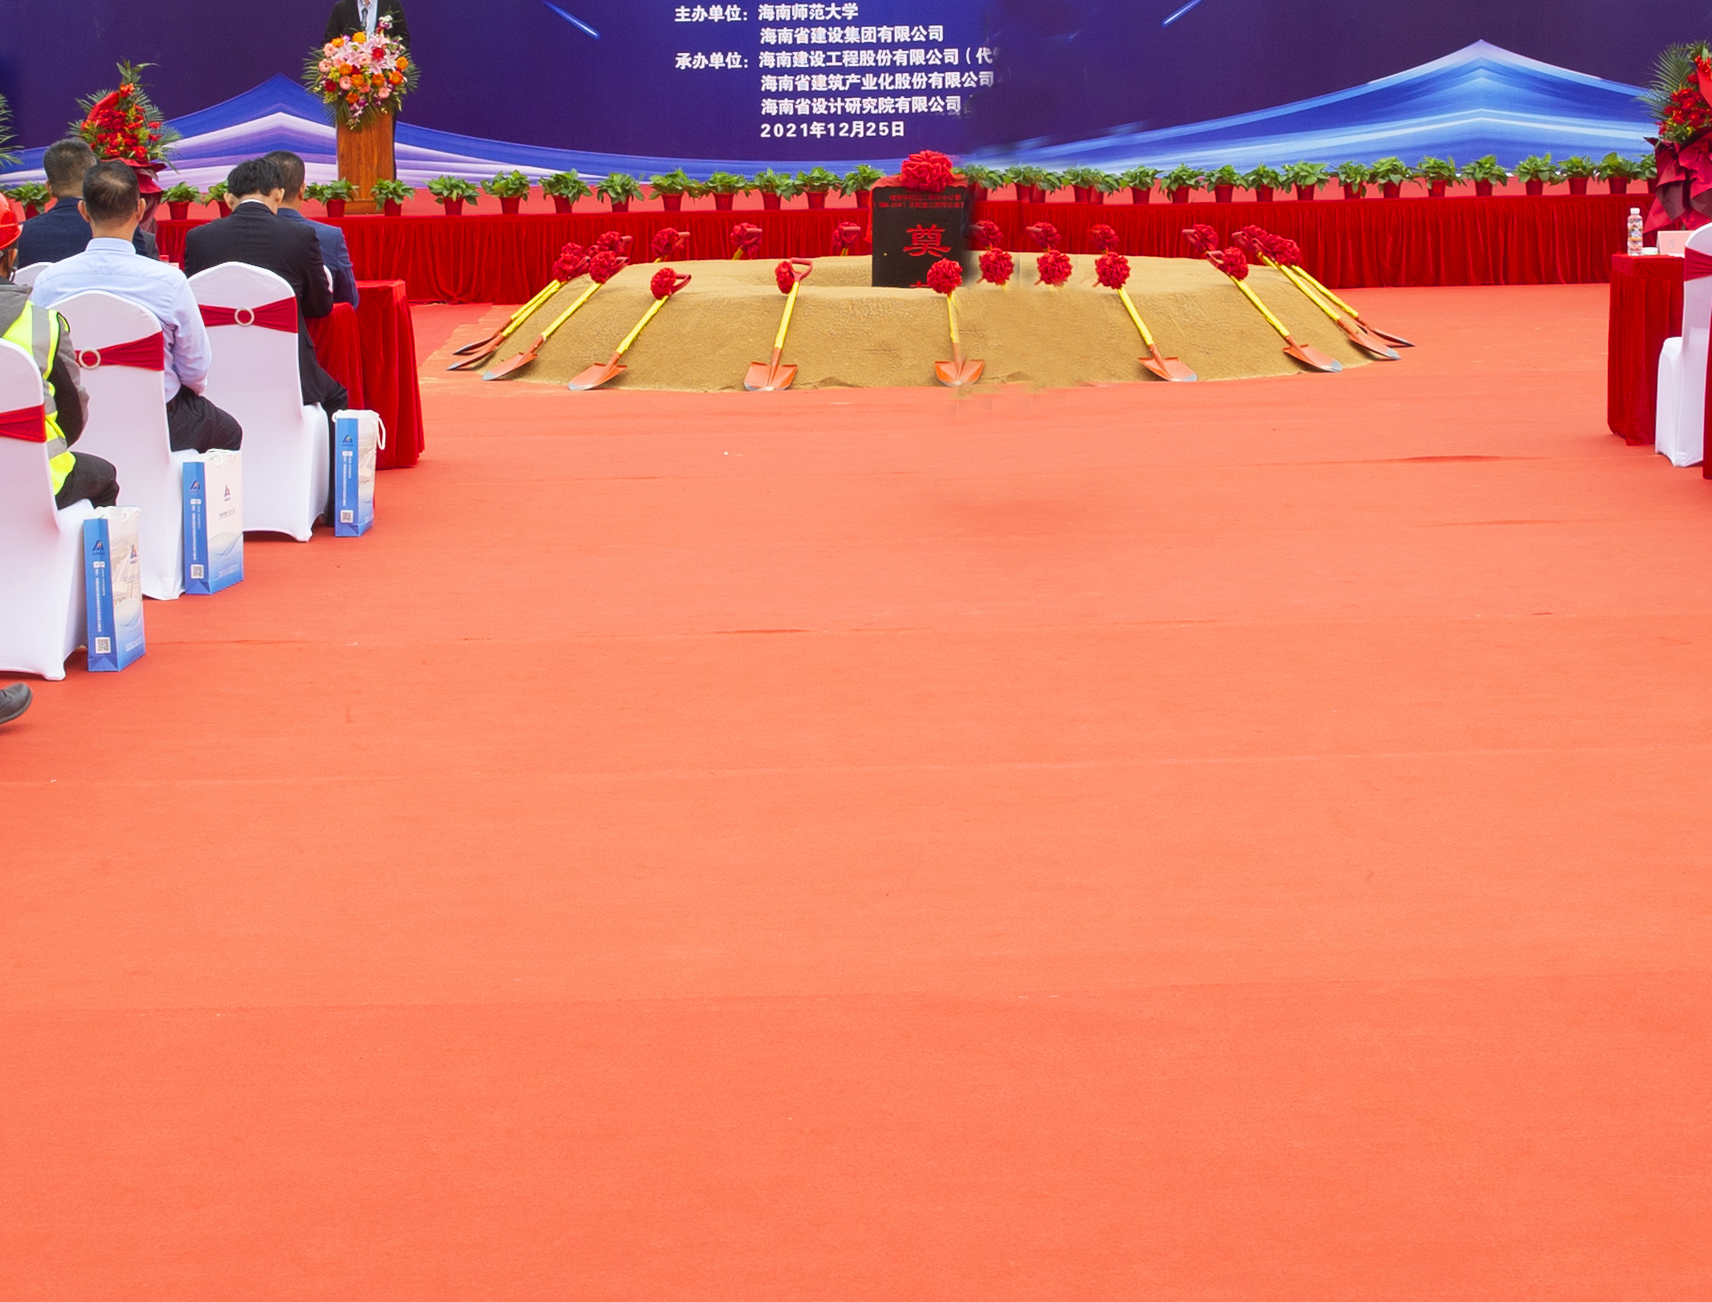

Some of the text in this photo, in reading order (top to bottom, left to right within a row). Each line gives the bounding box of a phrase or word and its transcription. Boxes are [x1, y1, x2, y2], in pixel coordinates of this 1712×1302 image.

[759, 25, 945, 45] 海南省建设集团有限公司
[760, 70, 995, 92] 海南省建筑产业化股份有限公司
[760, 95, 962, 116] 海南省设计研究院有限公司
[760, 120, 906, 139] 2021年12月25日
